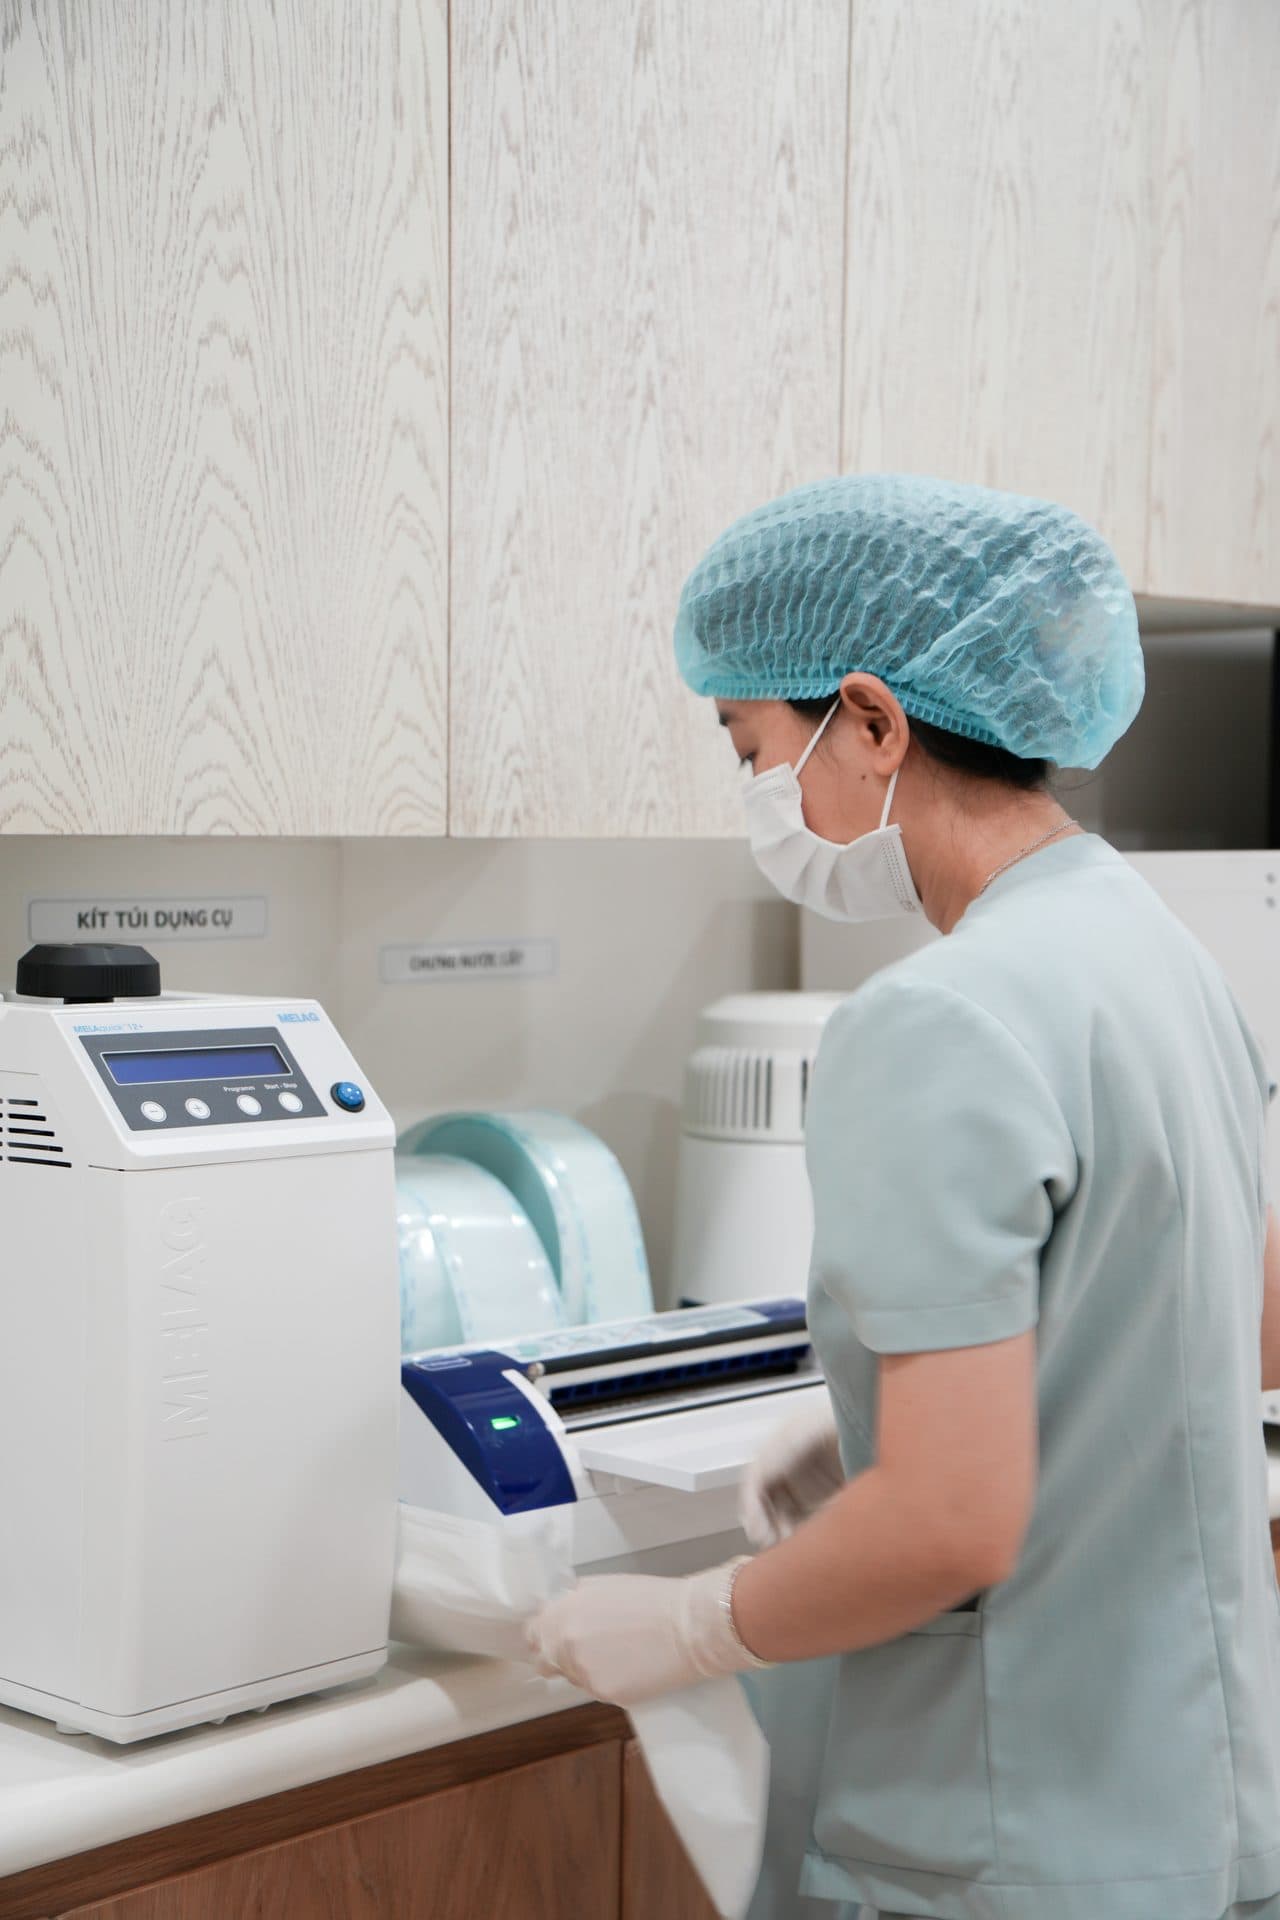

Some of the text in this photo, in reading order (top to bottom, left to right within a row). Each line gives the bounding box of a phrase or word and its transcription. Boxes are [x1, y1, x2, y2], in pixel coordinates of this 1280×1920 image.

[76, 905, 234, 931] KÍT TÚI DỤNG CỤ
[276, 1011, 321, 1023] MELAG
